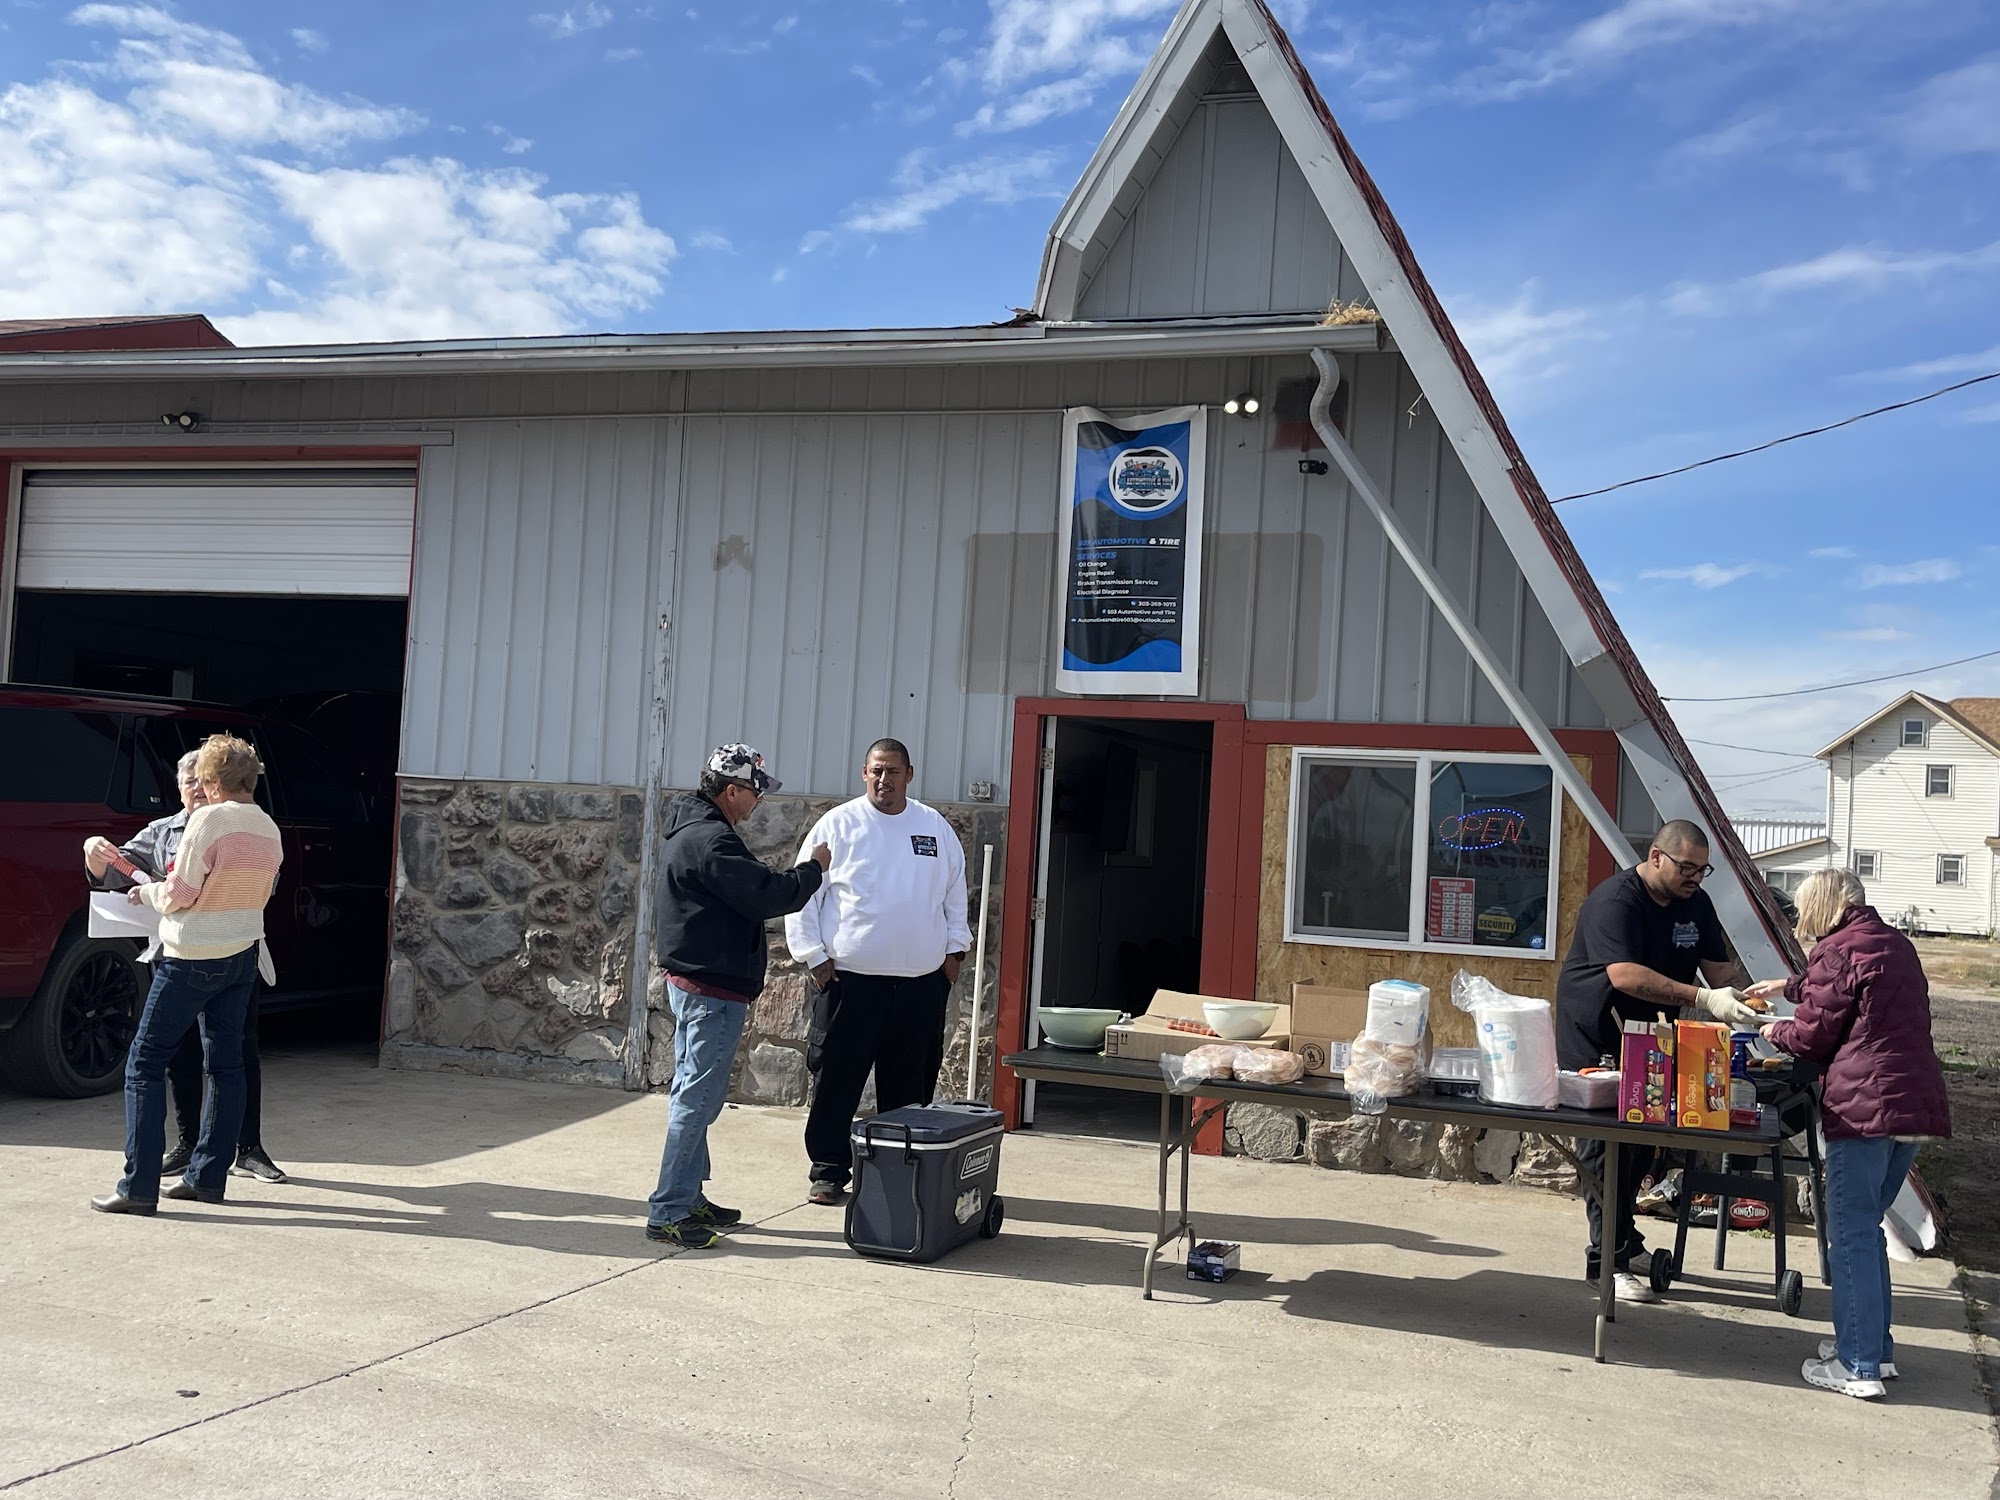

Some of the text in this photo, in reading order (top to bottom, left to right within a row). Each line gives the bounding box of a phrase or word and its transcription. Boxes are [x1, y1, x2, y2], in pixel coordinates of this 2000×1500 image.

[1077, 552, 1117, 560] SERVICES
[1439, 815, 1525, 843] OPEN
[1478, 919, 1515, 931] SECURITY
[1633, 1081, 1642, 1108] flavor
[1689, 1073, 1698, 1110] cheesy
[1633, 1112, 1641, 1121] 18
[1689, 1115, 1699, 1124] 18
[1733, 1205, 1766, 1218] KINGSFORD
